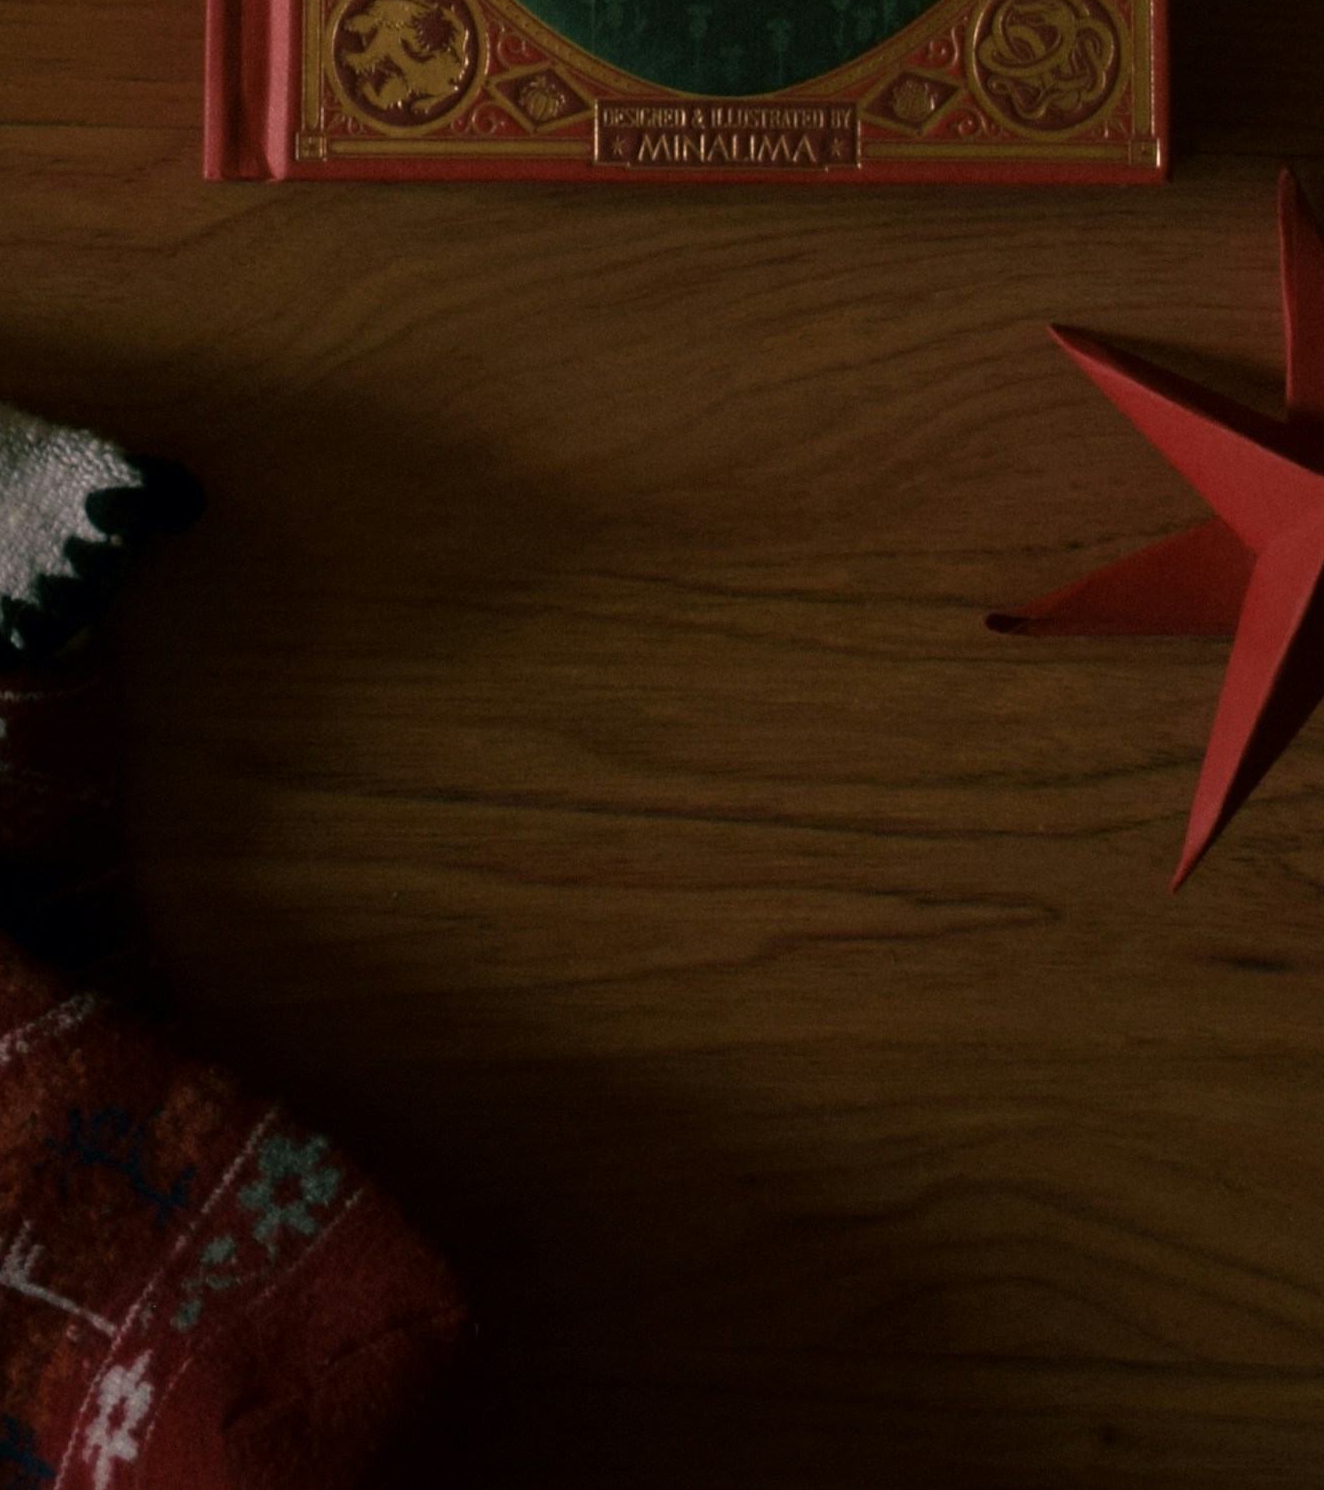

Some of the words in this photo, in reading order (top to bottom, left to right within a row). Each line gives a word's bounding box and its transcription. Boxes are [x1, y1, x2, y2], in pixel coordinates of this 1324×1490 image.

[602, 107, 687, 129] DESIGNED
[690, 107, 706, 129] &
[710, 107, 825, 129] ILLUSTRATED
[830, 107, 852, 129] BY
[636, 133, 818, 163] MINALIMA
